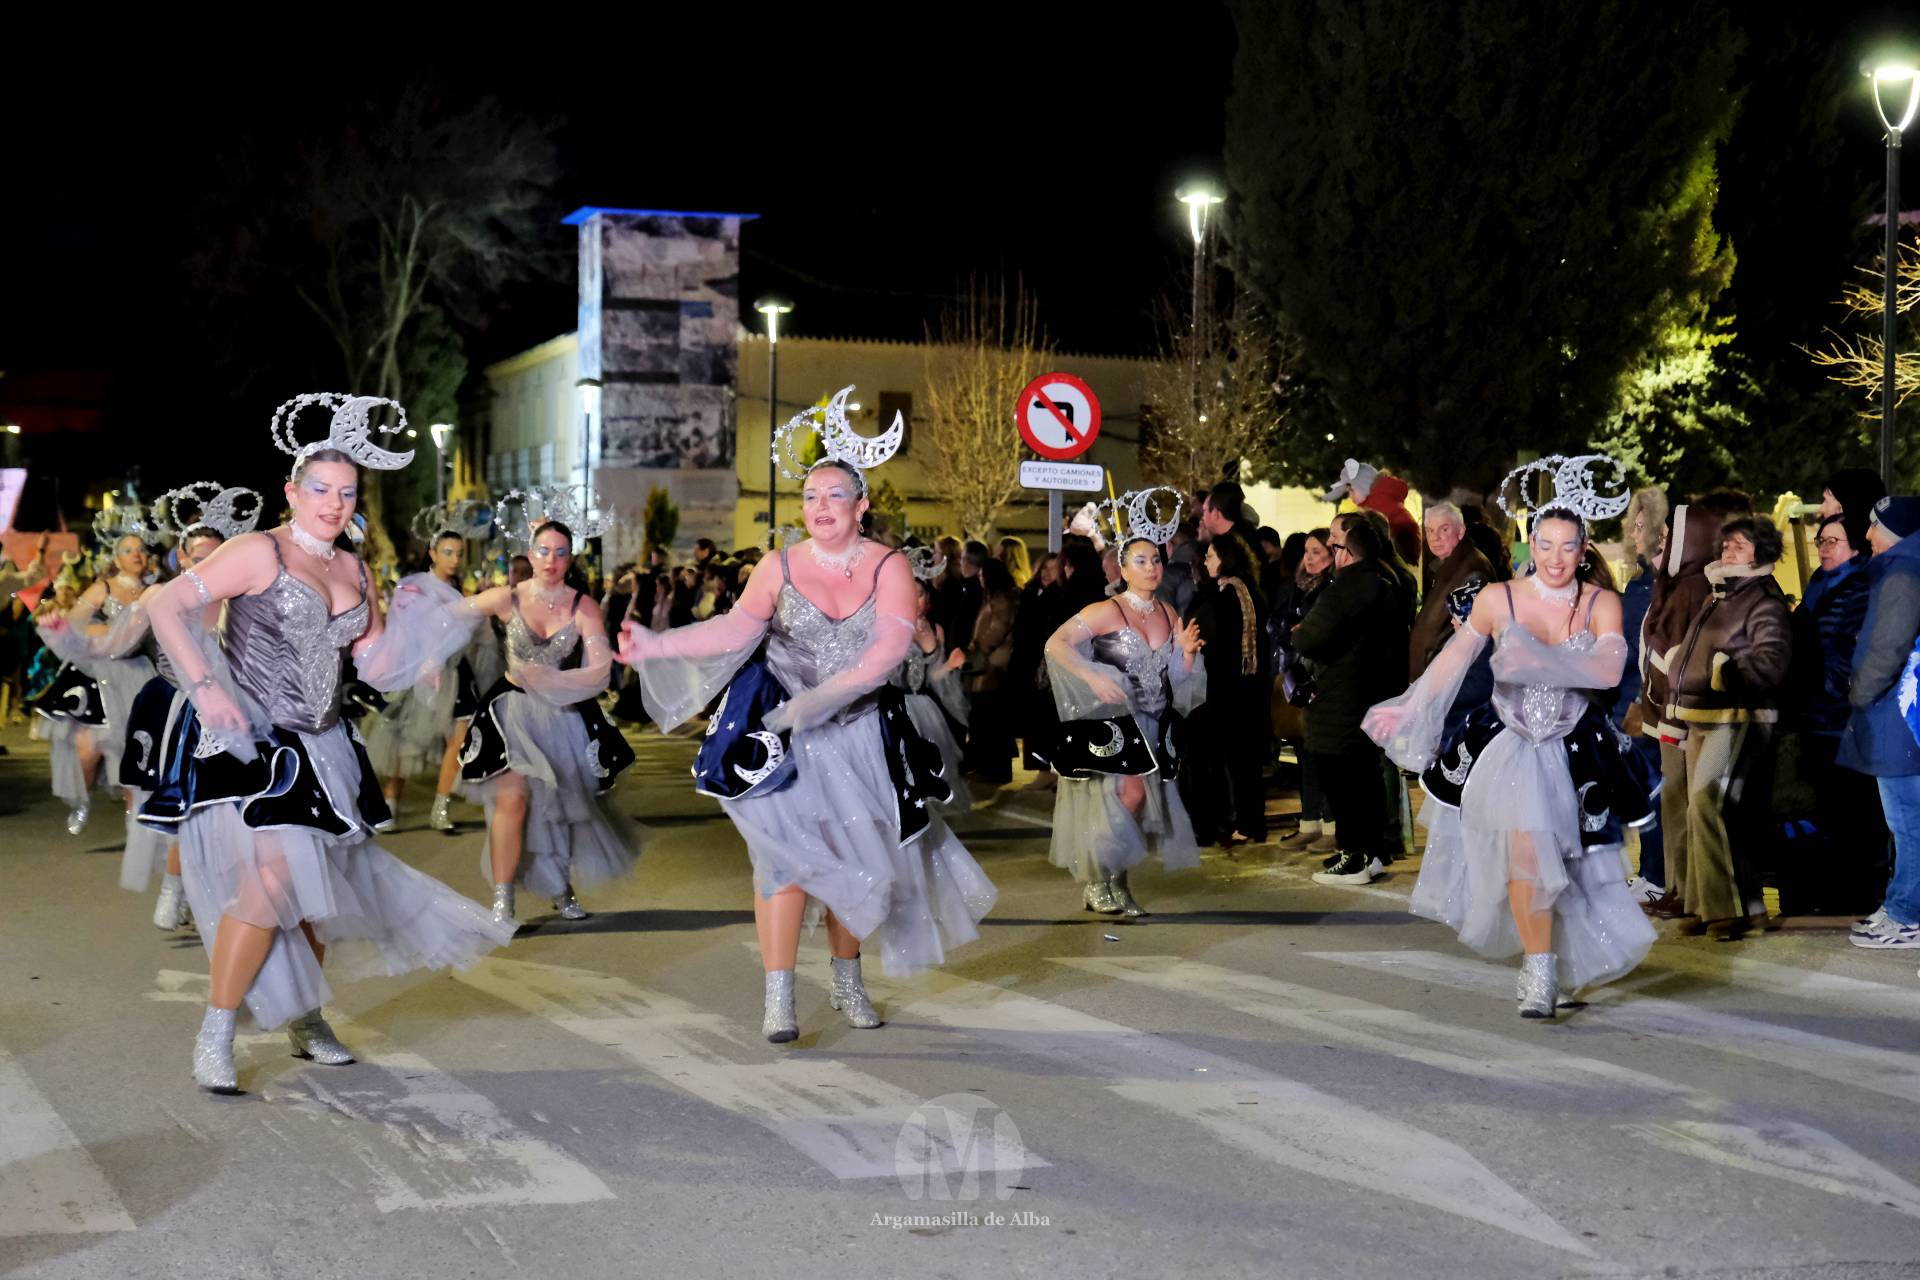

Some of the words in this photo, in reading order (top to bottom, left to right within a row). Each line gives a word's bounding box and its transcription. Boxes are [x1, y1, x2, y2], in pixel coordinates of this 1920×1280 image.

[1022, 466, 1058, 474] EXCEPTO
[1060, 468, 1101, 477] CAMIONES
[1042, 477, 1088, 485] AUTOBUSES
